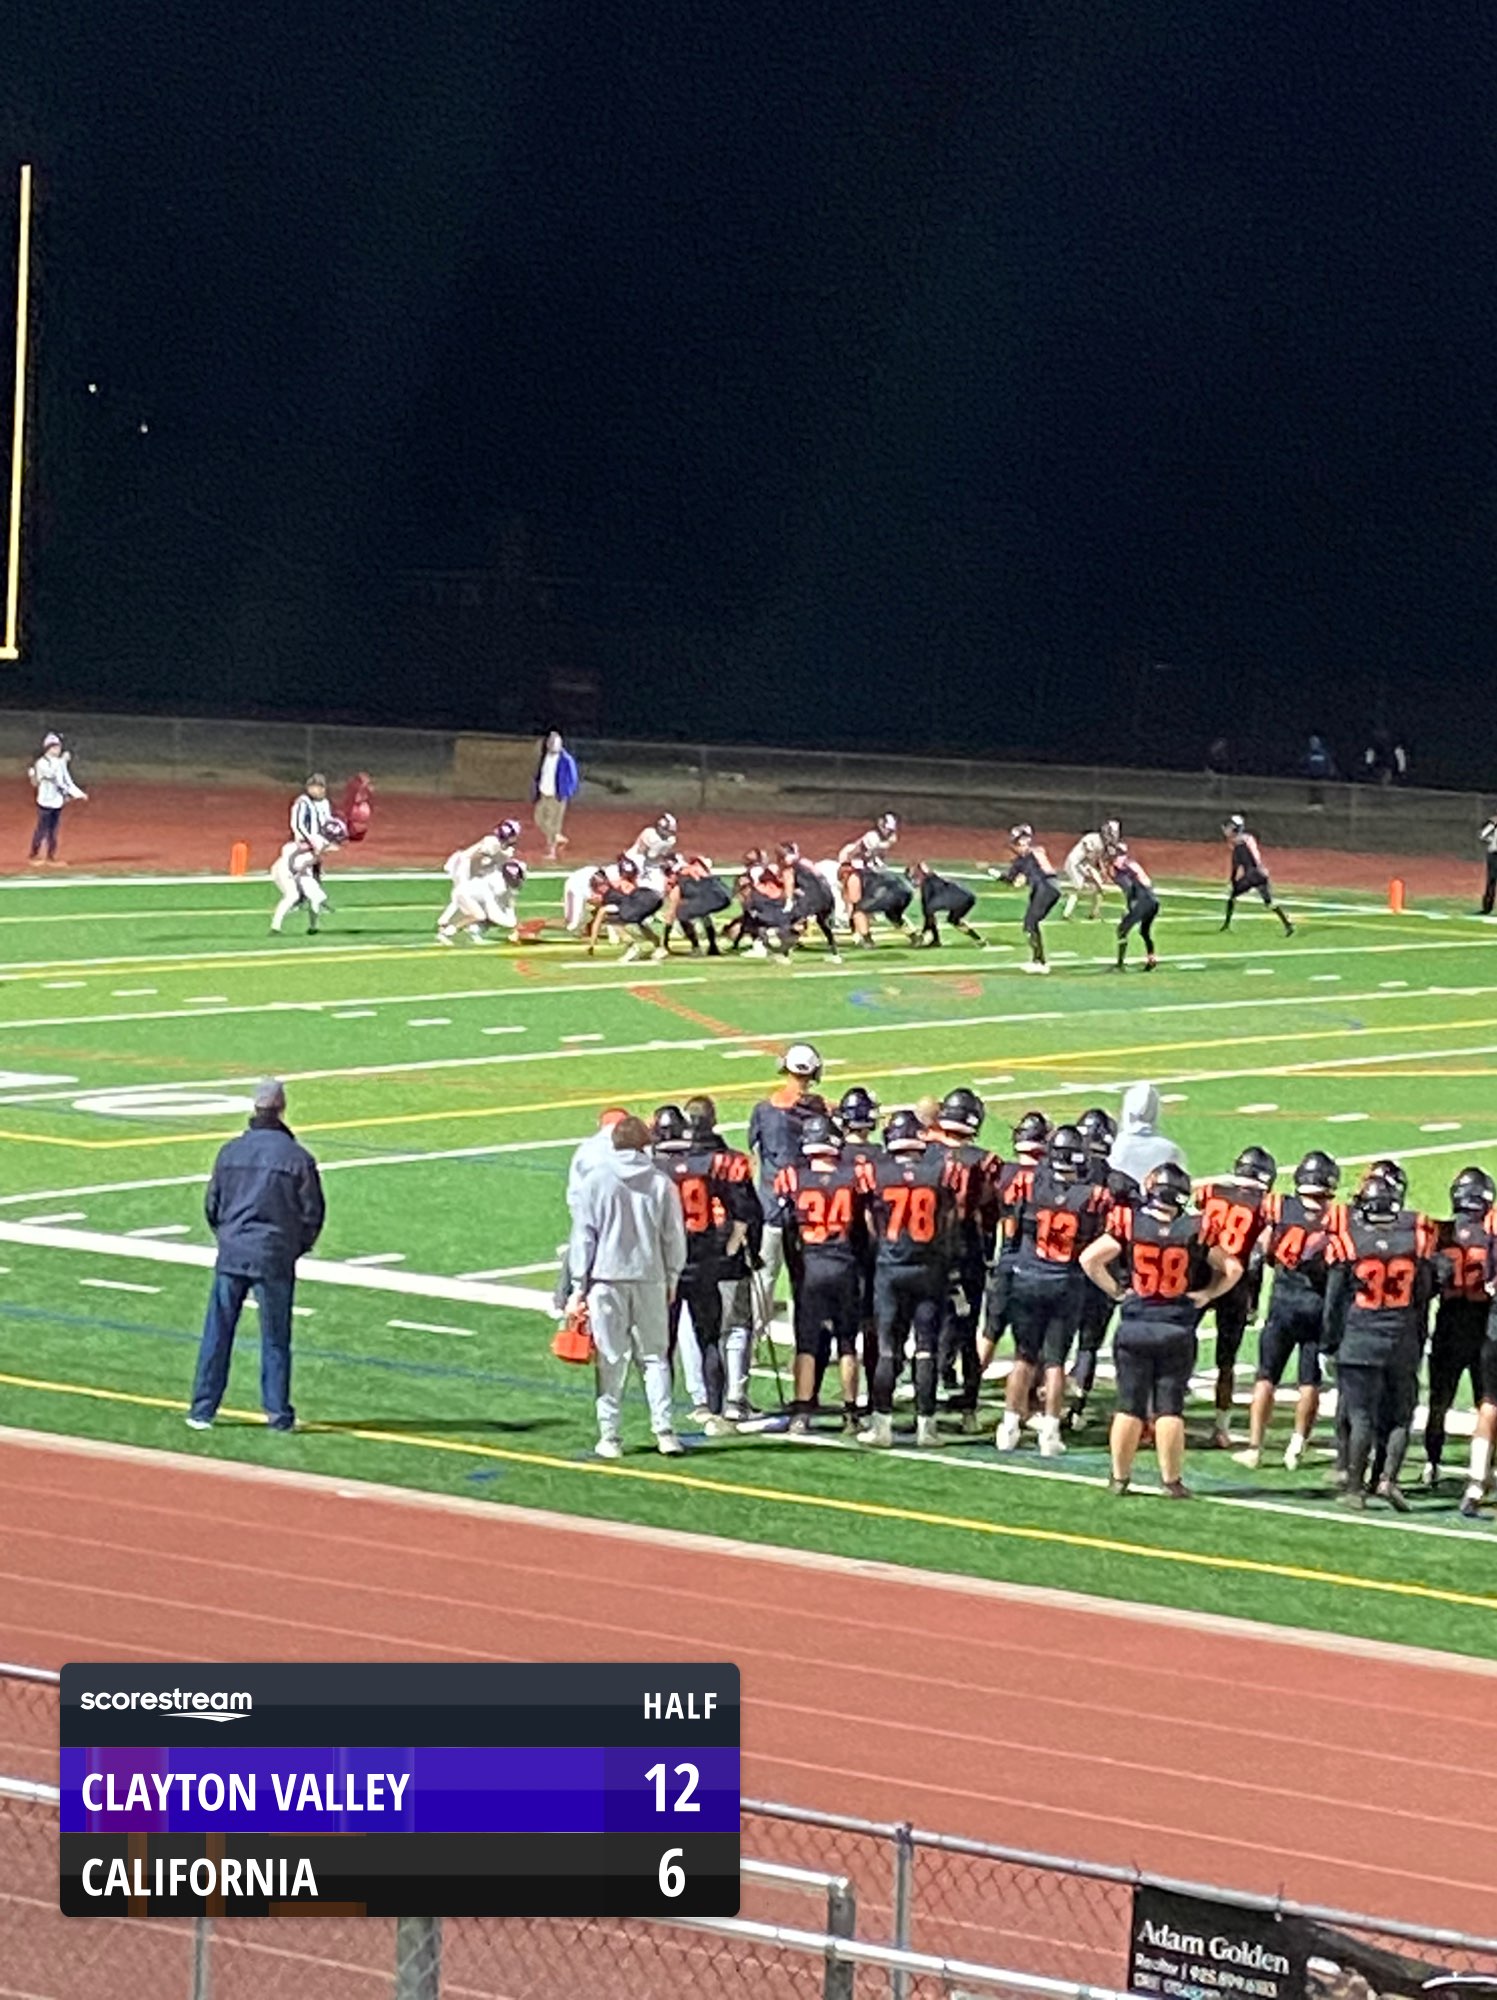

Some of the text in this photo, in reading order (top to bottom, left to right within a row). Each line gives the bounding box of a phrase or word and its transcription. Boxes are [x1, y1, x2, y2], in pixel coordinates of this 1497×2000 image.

[799, 1188, 851, 1244] 34
[883, 1188, 936, 1243] 78
[1036, 1209, 1078, 1262] 13
[1133, 1243, 1189, 1298] 58
[1355, 1258, 1415, 1310] 33
[1137, 1920, 1205, 1956] Adam
[1208, 1936, 1290, 1975] Golden
